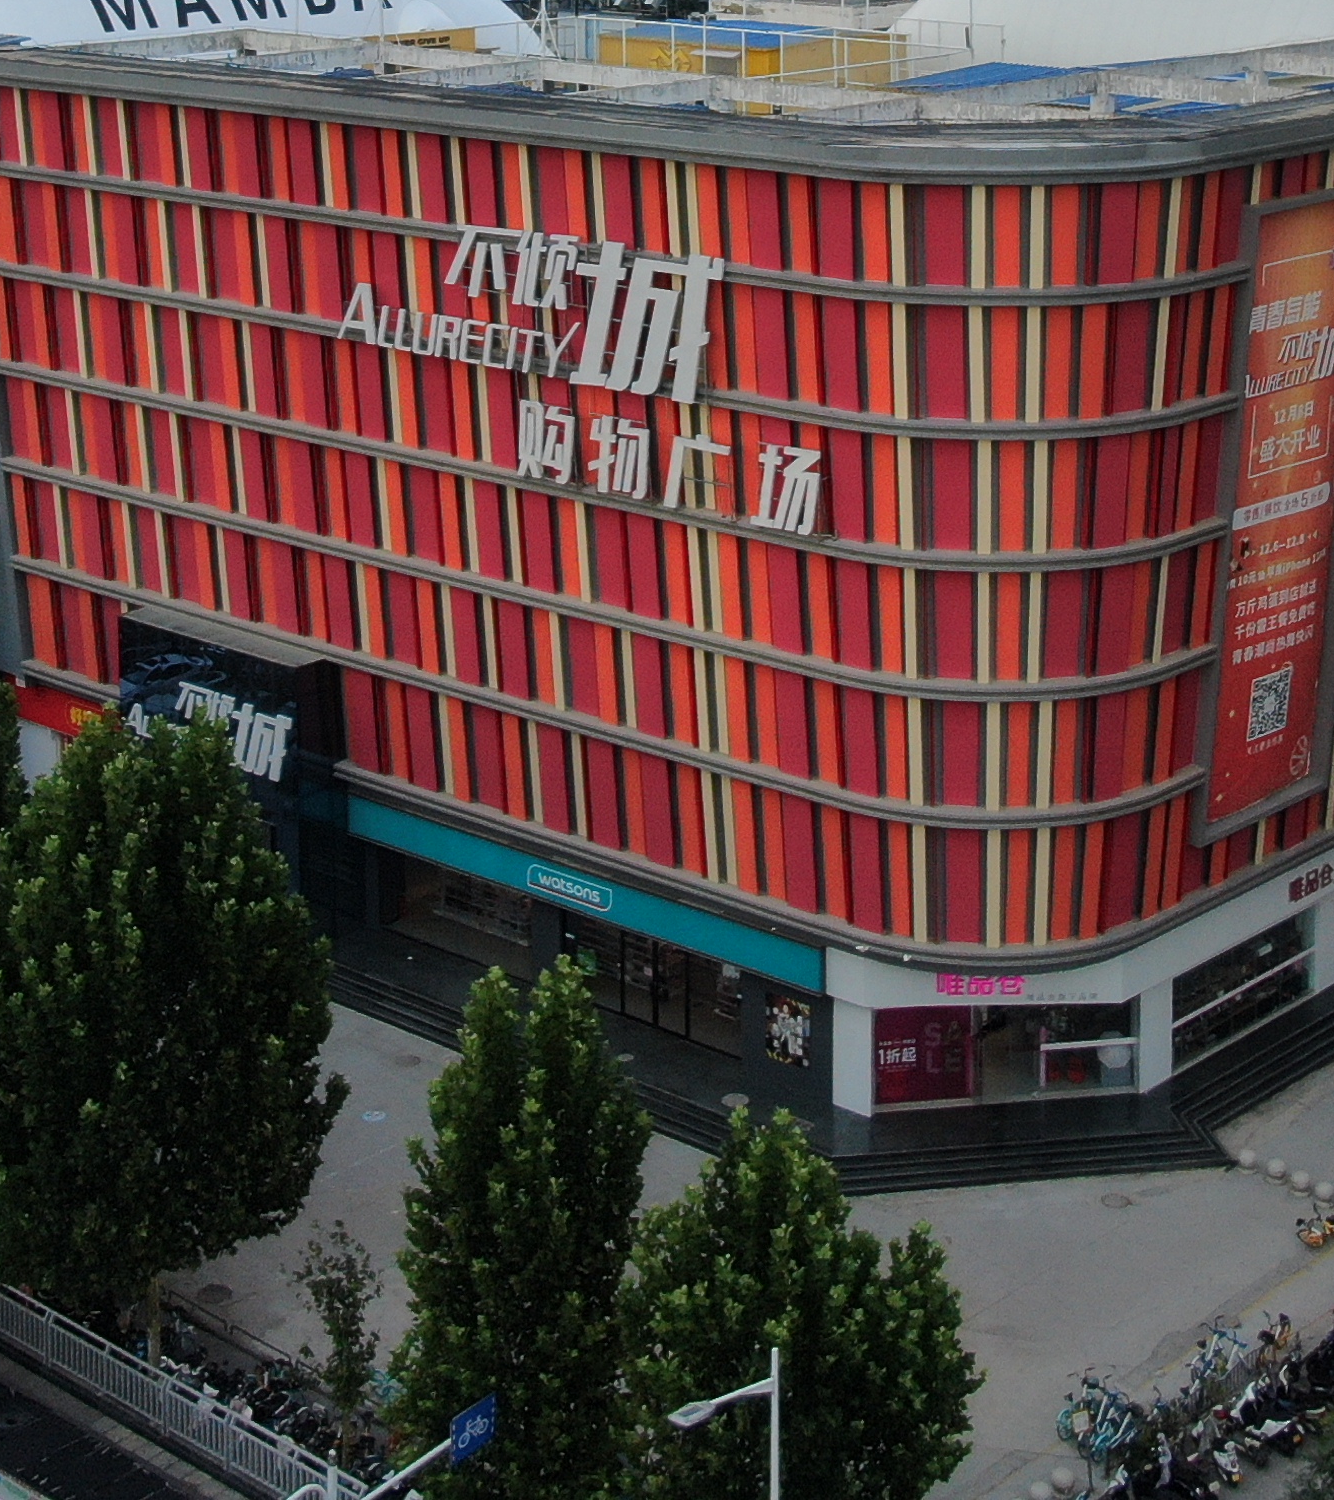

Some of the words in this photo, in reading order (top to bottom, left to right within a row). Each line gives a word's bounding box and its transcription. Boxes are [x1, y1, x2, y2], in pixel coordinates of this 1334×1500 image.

[337, 282, 581, 378] ALLURECITY
[517, 399, 822, 537] 购物广场
[538, 872, 601, 903] watsons
[936, 973, 1027, 996] 唯品仓
[878, 1047, 917, 1065] 1折起
